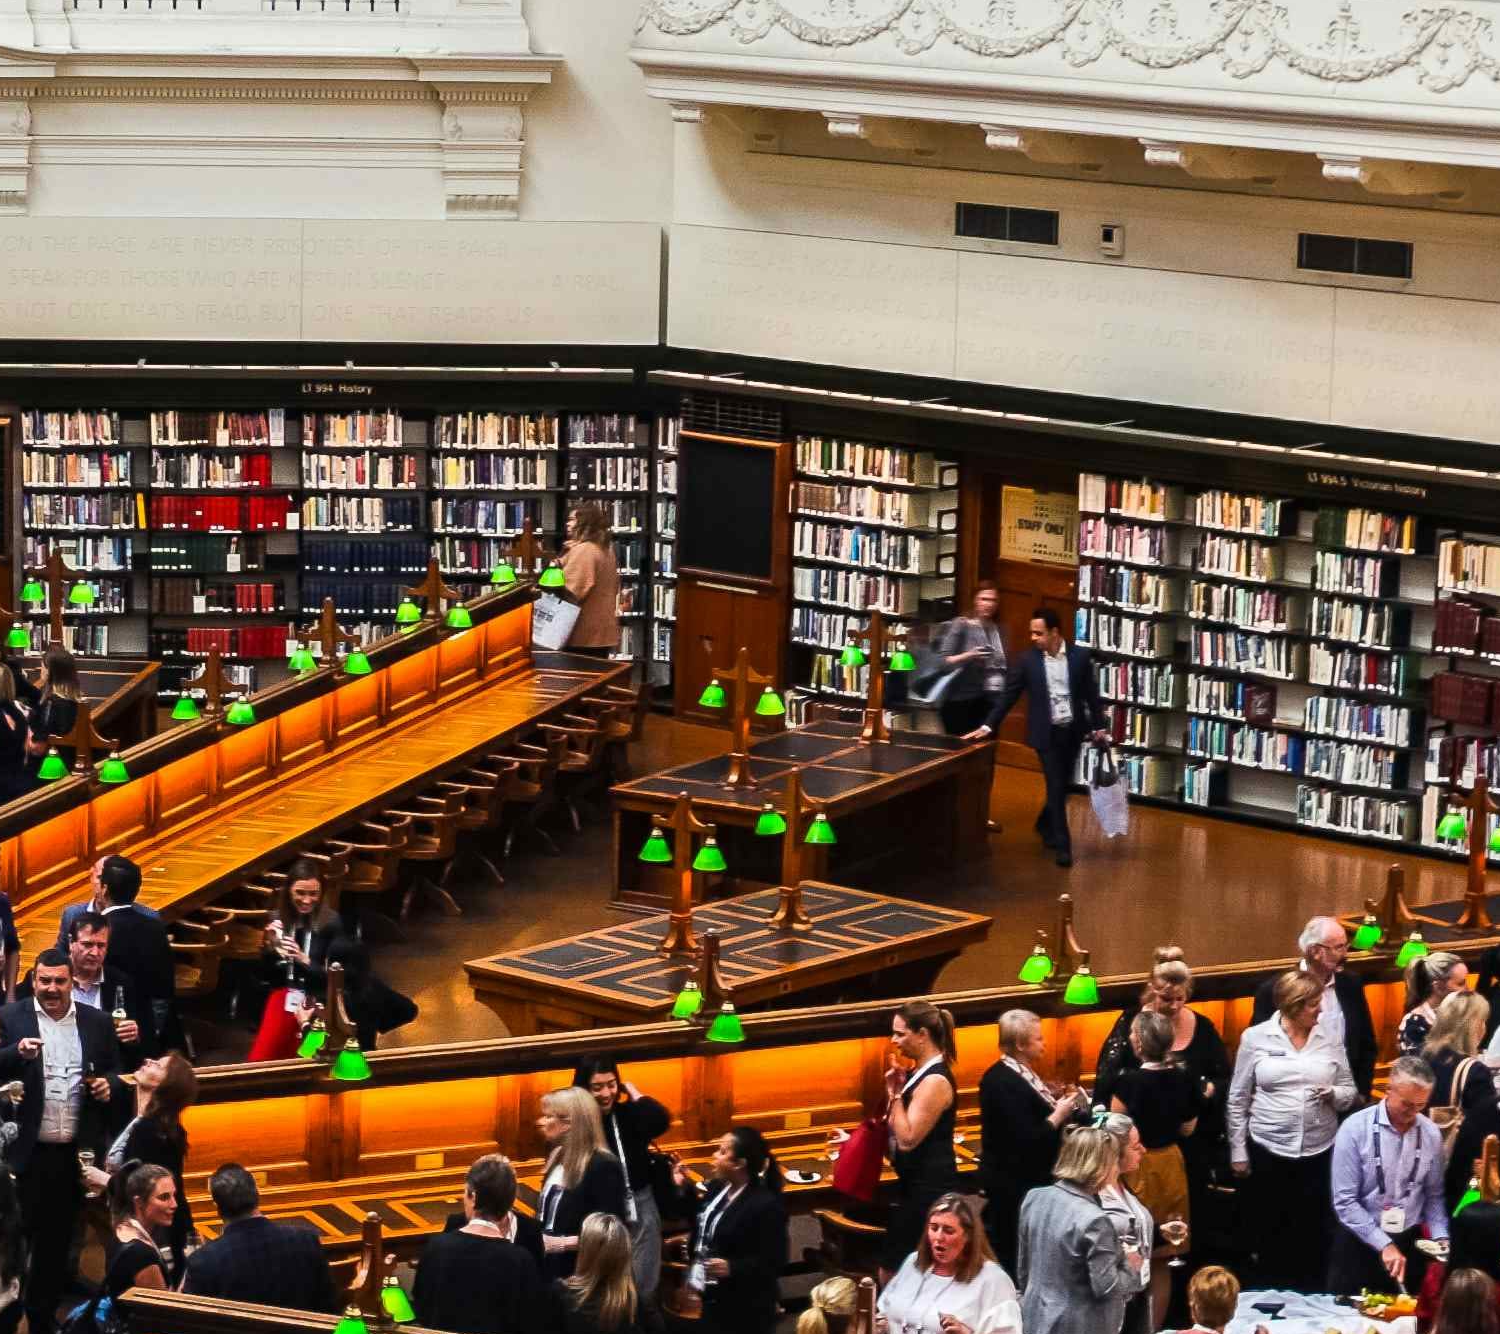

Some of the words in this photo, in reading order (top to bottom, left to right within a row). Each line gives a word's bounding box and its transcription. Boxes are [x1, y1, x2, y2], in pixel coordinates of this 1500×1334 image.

[302, 383, 312, 393] LT
[315, 383, 333, 393] 994
[338, 383, 373, 395] History
[1351, 477, 1392, 491] Victorian
[1394, 482, 1427, 498] history
[1017, 518, 1042, 532] STAFF
[1045, 522, 1065, 535] ONLY
